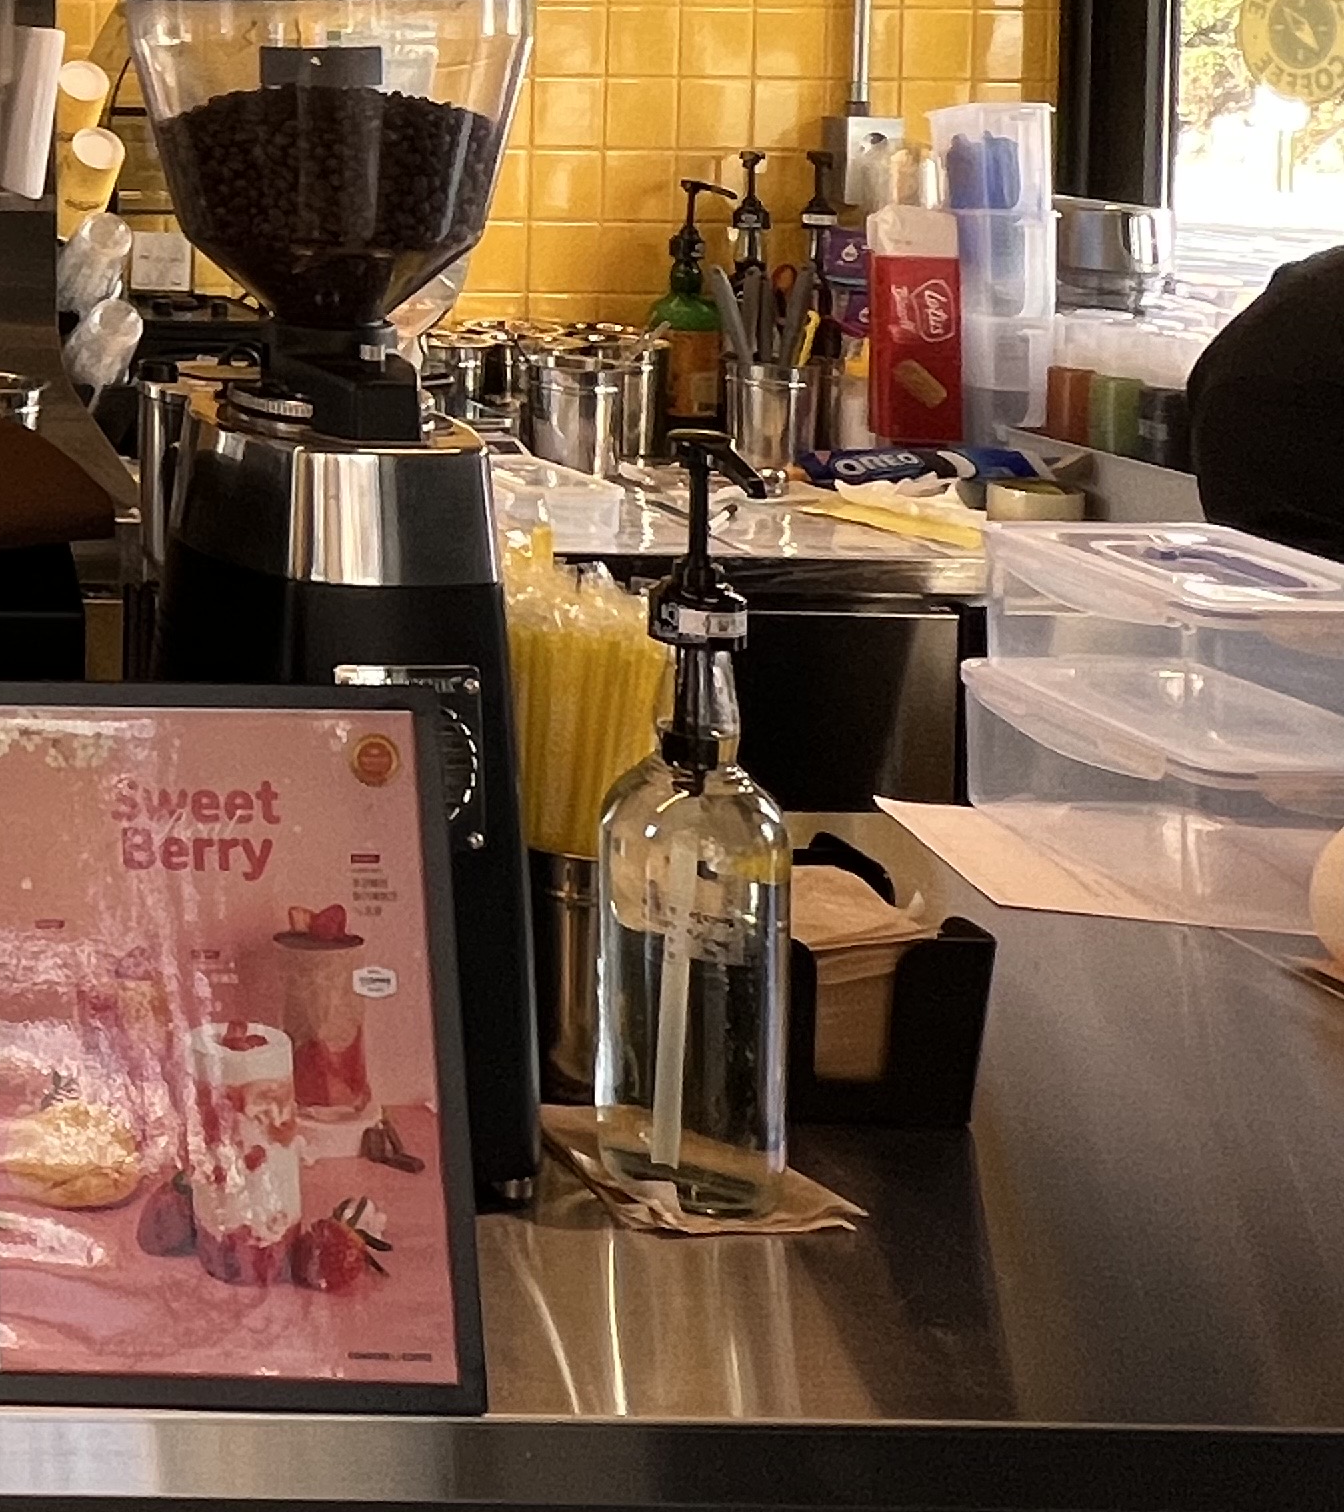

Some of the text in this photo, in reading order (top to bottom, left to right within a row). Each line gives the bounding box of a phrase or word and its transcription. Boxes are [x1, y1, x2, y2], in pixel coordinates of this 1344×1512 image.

[834, 451, 919, 476] OREO
[112, 776, 281, 826] Sweet
[121, 826, 274, 882] Berry
